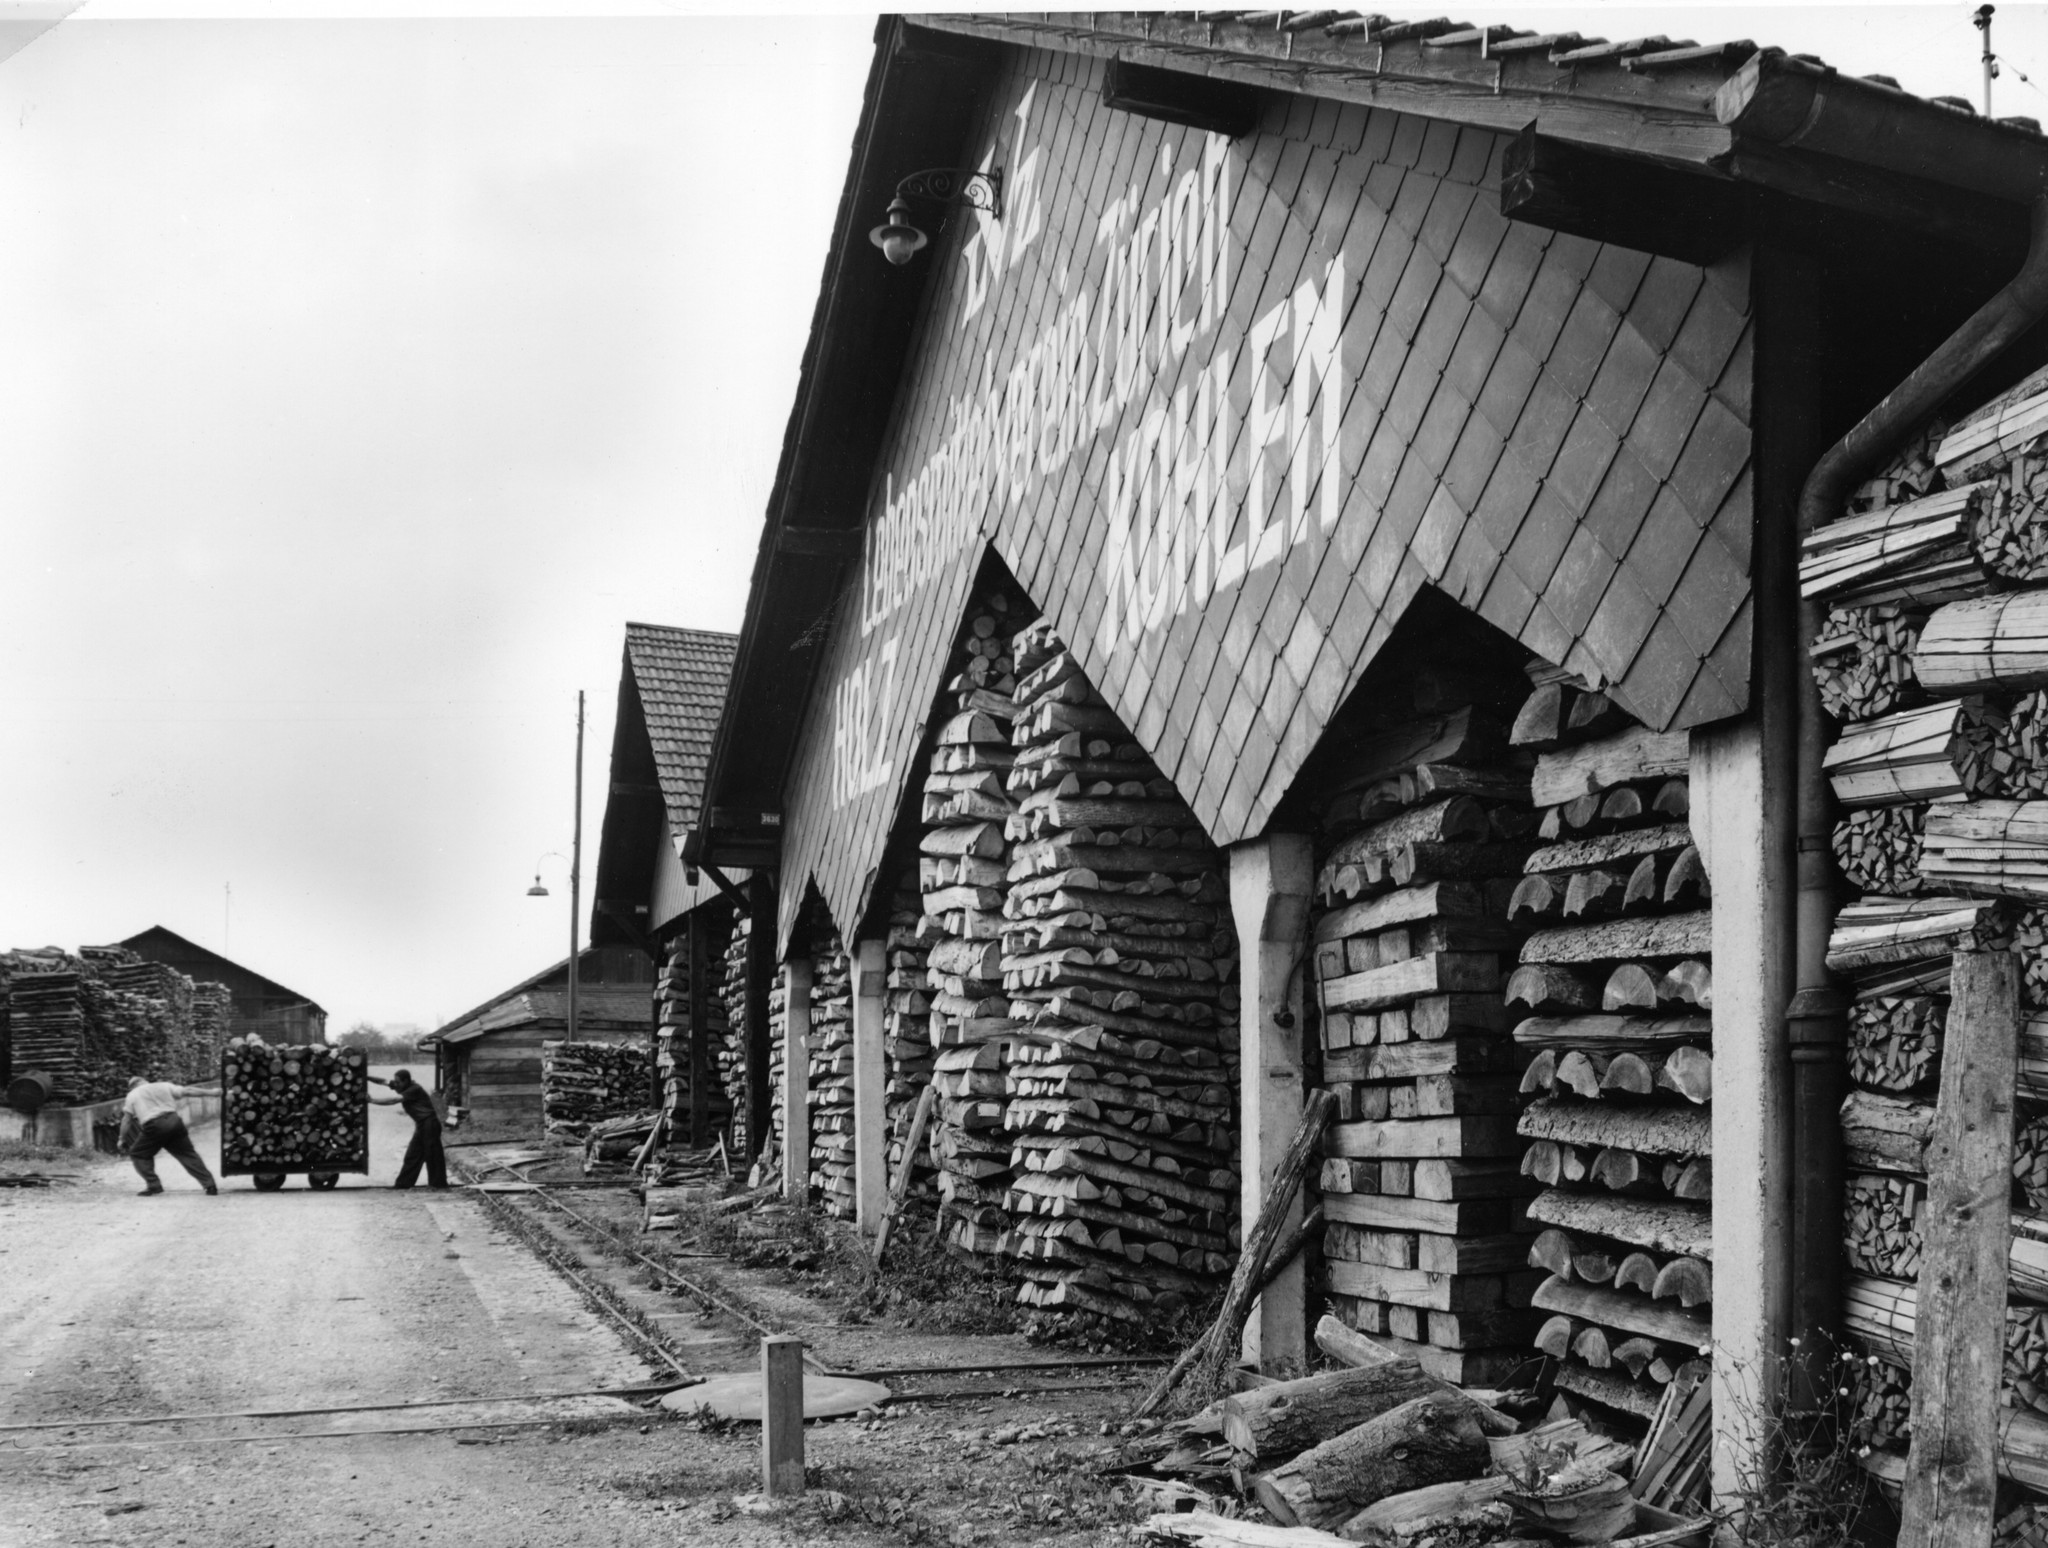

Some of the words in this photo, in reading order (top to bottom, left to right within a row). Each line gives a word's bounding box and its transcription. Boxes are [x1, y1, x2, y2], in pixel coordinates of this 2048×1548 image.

[1090, 130, 1231, 438] Zürich
[1105, 250, 1345, 656] KOHLEN
[833, 636, 898, 811] HOLZ
